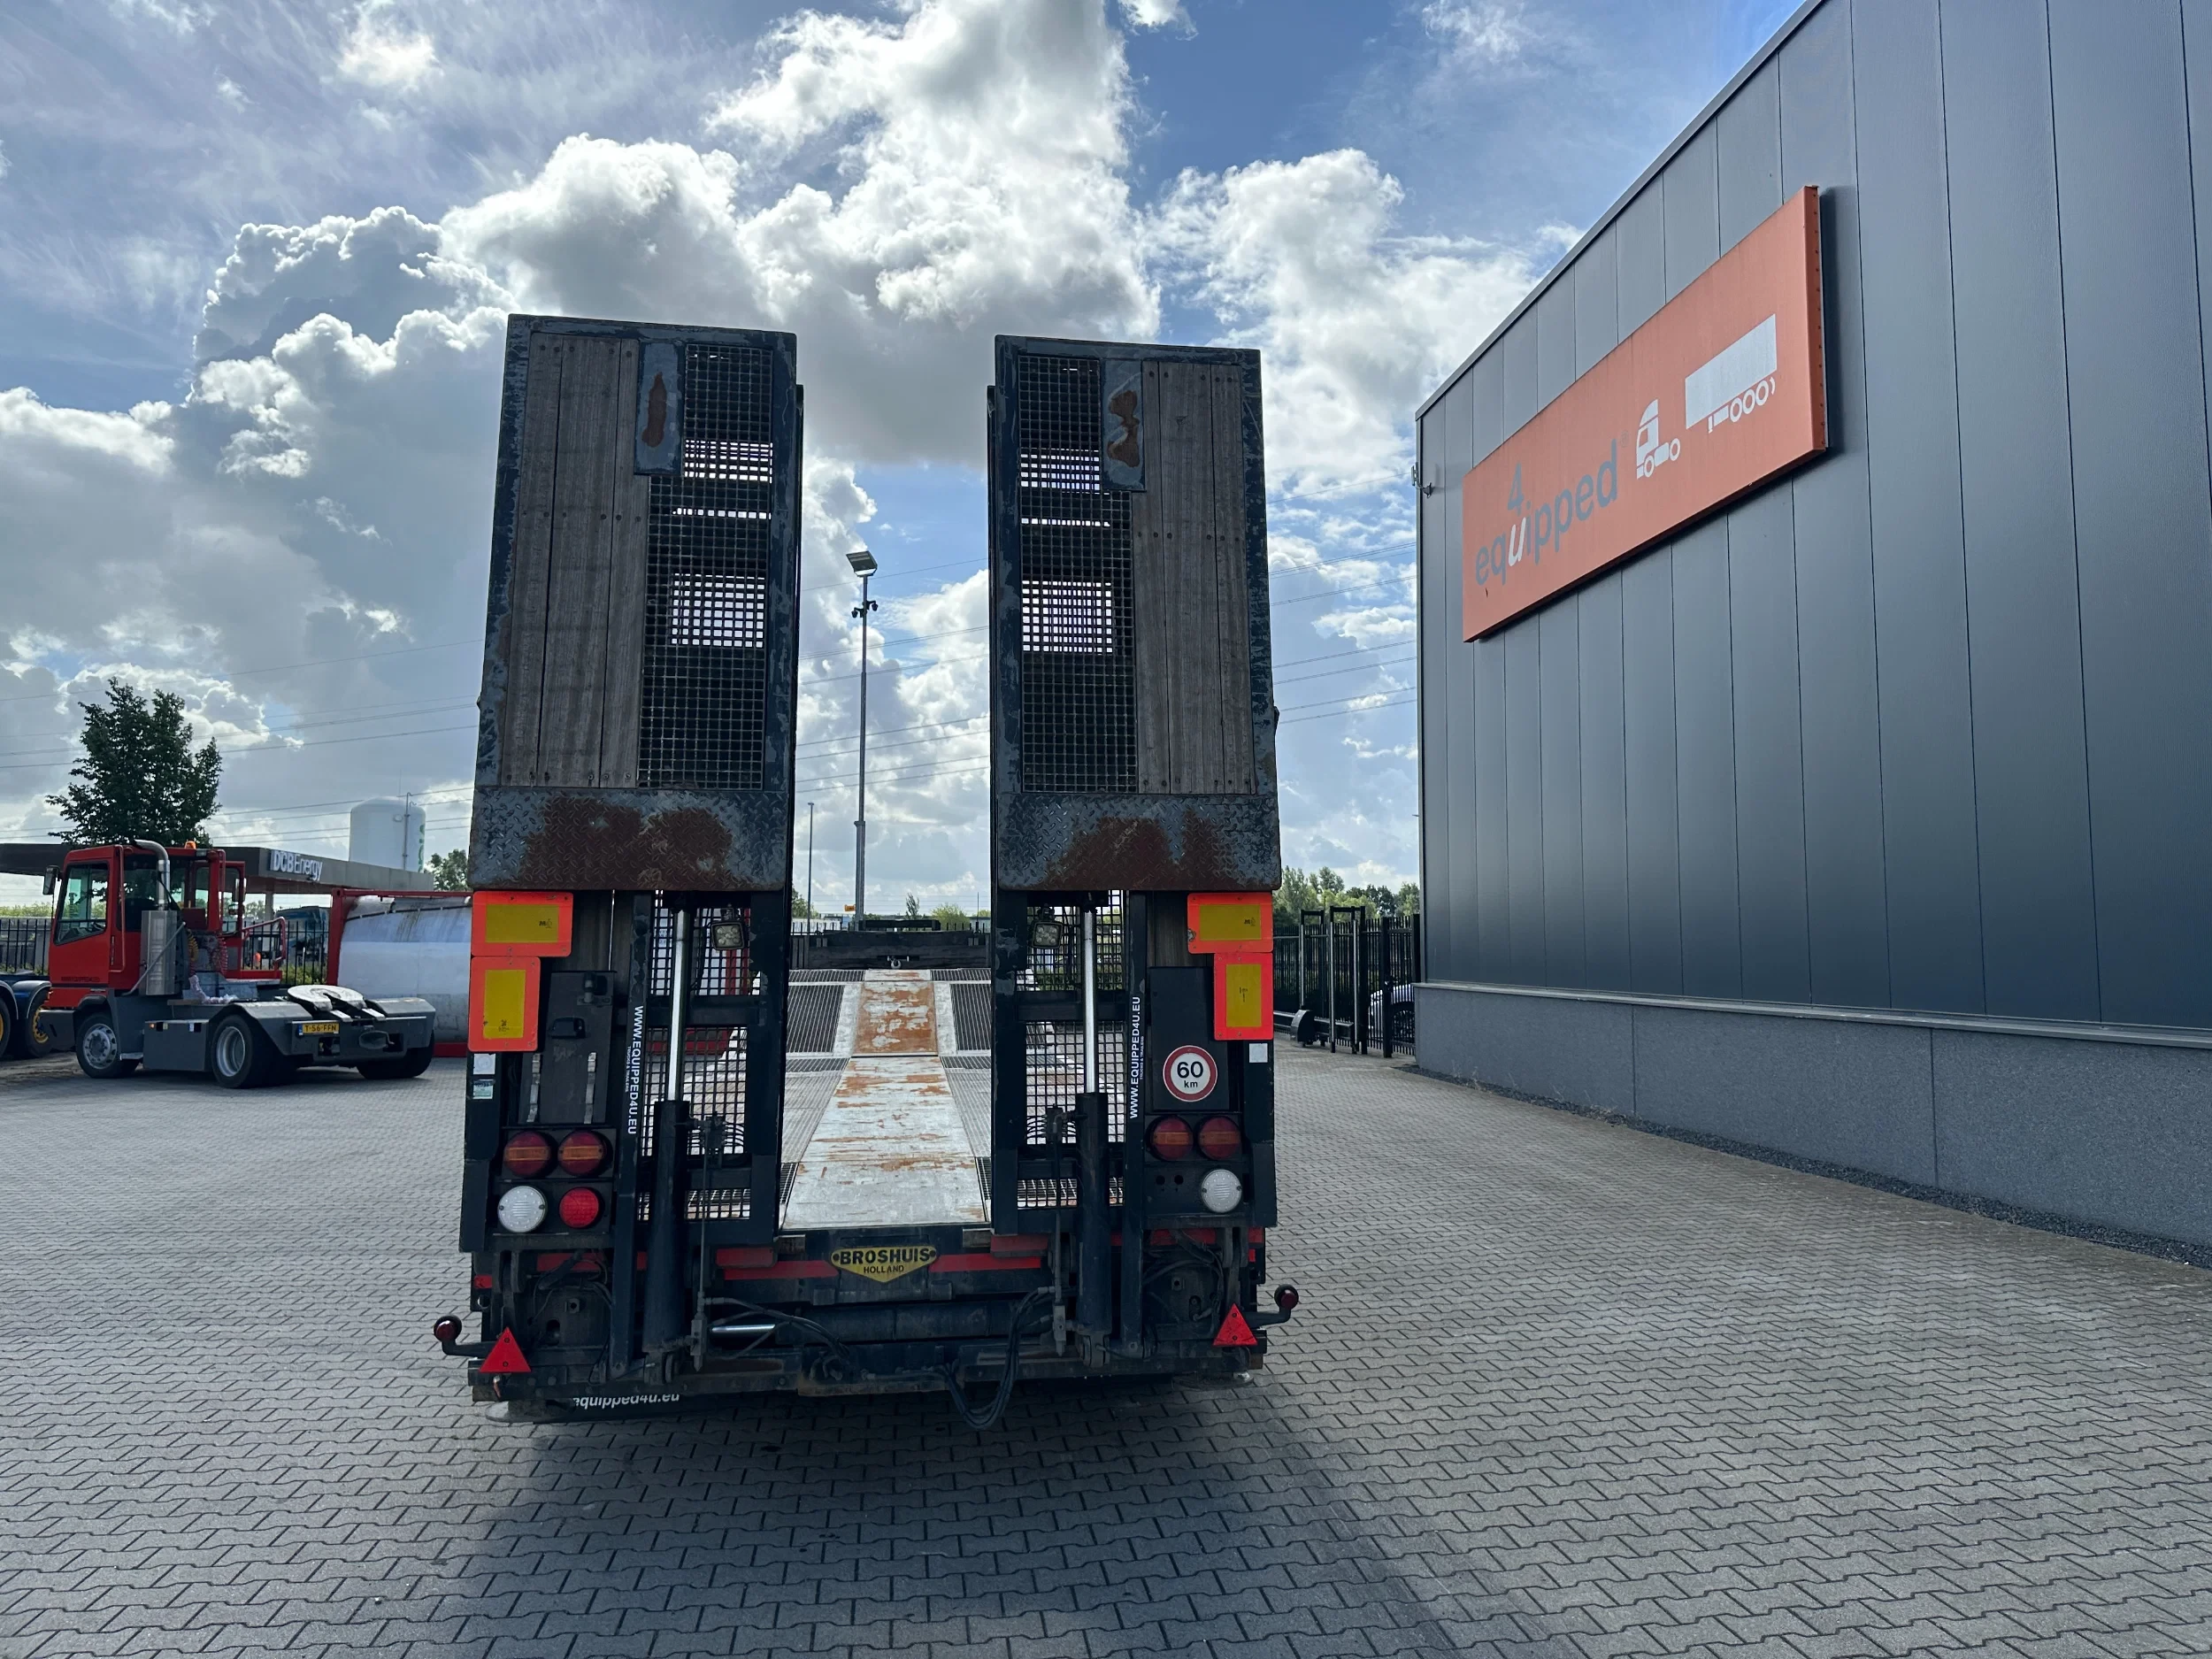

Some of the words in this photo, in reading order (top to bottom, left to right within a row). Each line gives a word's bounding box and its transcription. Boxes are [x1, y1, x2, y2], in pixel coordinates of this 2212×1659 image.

[1475, 439, 1618, 586] equipped
[1508, 463, 1525, 517] 4
[627, 1005, 643, 1134] WWW.EQUIPPED4U.EU
[1130, 996, 1141, 1119] WWW.EQUIPPED4U.EU
[1177, 1061, 1203, 1079] 60
[840, 1248, 930, 1265] BROSHUIS
[864, 1264, 904, 1274] HOLLAND
